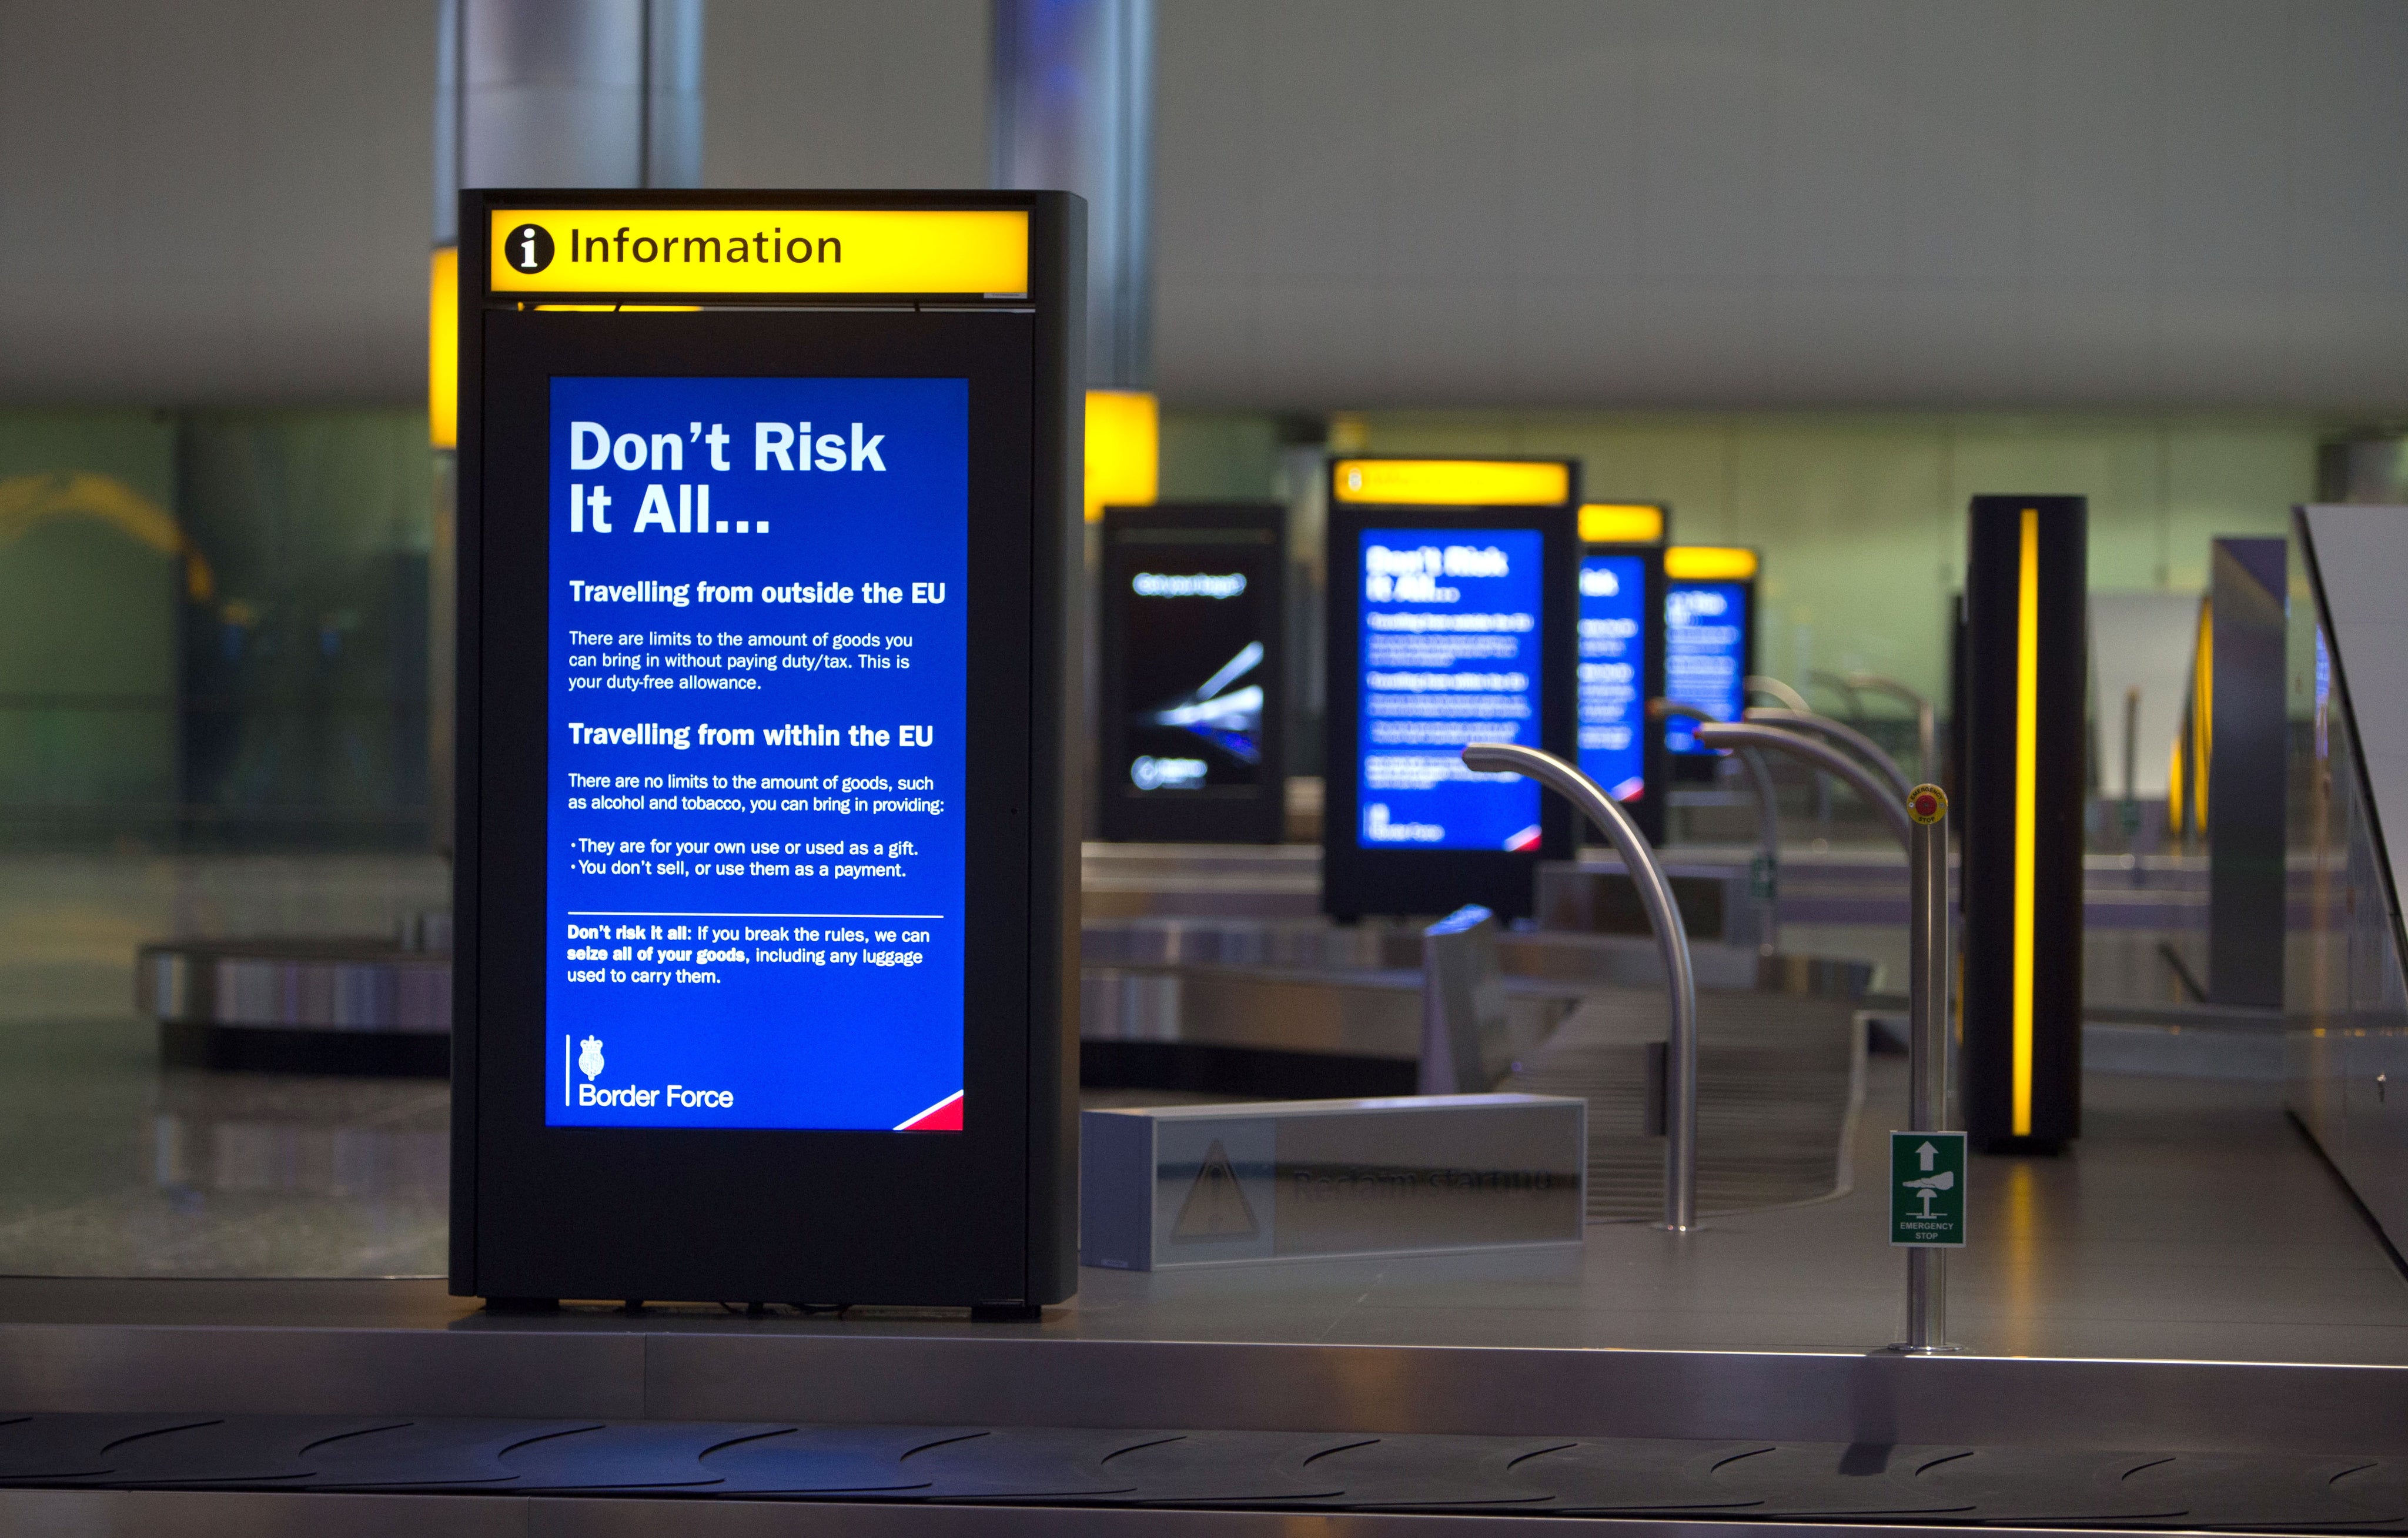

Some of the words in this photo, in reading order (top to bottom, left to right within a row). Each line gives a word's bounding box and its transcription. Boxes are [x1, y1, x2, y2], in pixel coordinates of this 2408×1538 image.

[571, 227, 842, 263] Information
[571, 421, 730, 472] Don't
[755, 422, 887, 472] Risk
[571, 483, 612, 533] It
[633, 484, 769, 533] All...
[569, 580, 690, 607] Travelling
[696, 580, 753, 603] from
[761, 581, 854, 604] outside
[861, 582, 903, 604] the
[912, 582, 945, 604] EU
[568, 630, 613, 646] There
[618, 634, 644, 646] are
[650, 631, 691, 646] limits
[696, 632, 713, 646] to
[717, 631, 743, 646] the
[748, 633, 808, 647] amount
[812, 632, 829, 647] of
[832, 633, 881, 650] goods
[885, 636, 912, 650] you
[568, 655, 597, 667] can
[602, 653, 641, 670] bring
[646, 653, 660, 667] in
[664, 653, 722, 668] without
[727, 653, 778, 671] paying
[782, 654, 852, 671] duty/tax.
[858, 654, 891, 669] This
[897, 654, 910, 669] is
[568, 677, 603, 691] your
[606, 674, 674, 692] duty-free
[678, 675, 761, 690] allowance.
[568, 723, 691, 750] Travelling
[697, 723, 755, 745] from
[762, 724, 840, 746] within
[848, 724, 890, 747] the
[899, 725, 933, 747] EU
[568, 773, 611, 788] There
[615, 776, 640, 788] are
[644, 777, 663, 788] no
[668, 774, 708, 789] limits
[712, 775, 728, 789] to
[731, 774, 757, 789] the
[761, 776, 819, 790] amount
[822, 775, 839, 790] of
[841, 775, 892, 793] goods,
[897, 776, 934, 790] such
[1910, 787, 1944, 800] EMERGENCY
[568, 797, 587, 810] as
[591, 795, 644, 810] alcohol
[648, 795, 677, 810] and
[681, 795, 745, 813] tobacco,
[750, 799, 777, 814] you
[781, 799, 808, 811] can
[813, 797, 851, 815] bring
[855, 797, 868, 811] in
[873, 797, 944, 815] providing:
[578, 838, 616, 856] They
[620, 841, 646, 854] are
[650, 838, 672, 854] for
[675, 842, 710, 857] your
[714, 842, 745, 854] own
[751, 842, 780, 854] use
[784, 842, 801, 855] or
[805, 840, 844, 855] used
[849, 843, 869, 855] as
[873, 844, 884, 855] a
[888, 841, 918, 859] gift.
[578, 860, 606, 874] You
[611, 860, 652, 875] don't
[657, 860, 689, 877] sell,
[694, 864, 711, 875] or
[715, 864, 745, 876] use
[749, 861, 790, 876] them
[794, 864, 814, 877] as
[818, 865, 829, 877] a
[834, 863, 906, 880] payment.
[567, 924, 611, 940] Don't
[616, 924, 646, 940] risk
[651, 925, 663, 940] it
[667, 925, 691, 941] all:
[698, 925, 709, 941] If
[712, 929, 740, 944] you
[745, 926, 790, 941] break
[793, 927, 820, 942] the
[825, 927, 869, 944] rules,
[874, 931, 897, 942] we
[901, 931, 930, 943] can
[567, 945, 608, 961] seize
[612, 946, 632, 961] all
[637, 946, 654, 961] of
[657, 949, 693, 964] your
[695, 947, 750, 965] goods,
[756, 947, 826, 966] including
[830, 951, 858, 967] any
[862, 948, 923, 967] luggage
[567, 968, 606, 982] used
[610, 968, 627, 983] to
[631, 971, 672, 987] carry
[675, 968, 721, 984] them.
[578, 1084, 660, 1108] Border
[667, 1085, 734, 1108] Force
[1900, 1222, 1954, 1231] EMERGENCY
